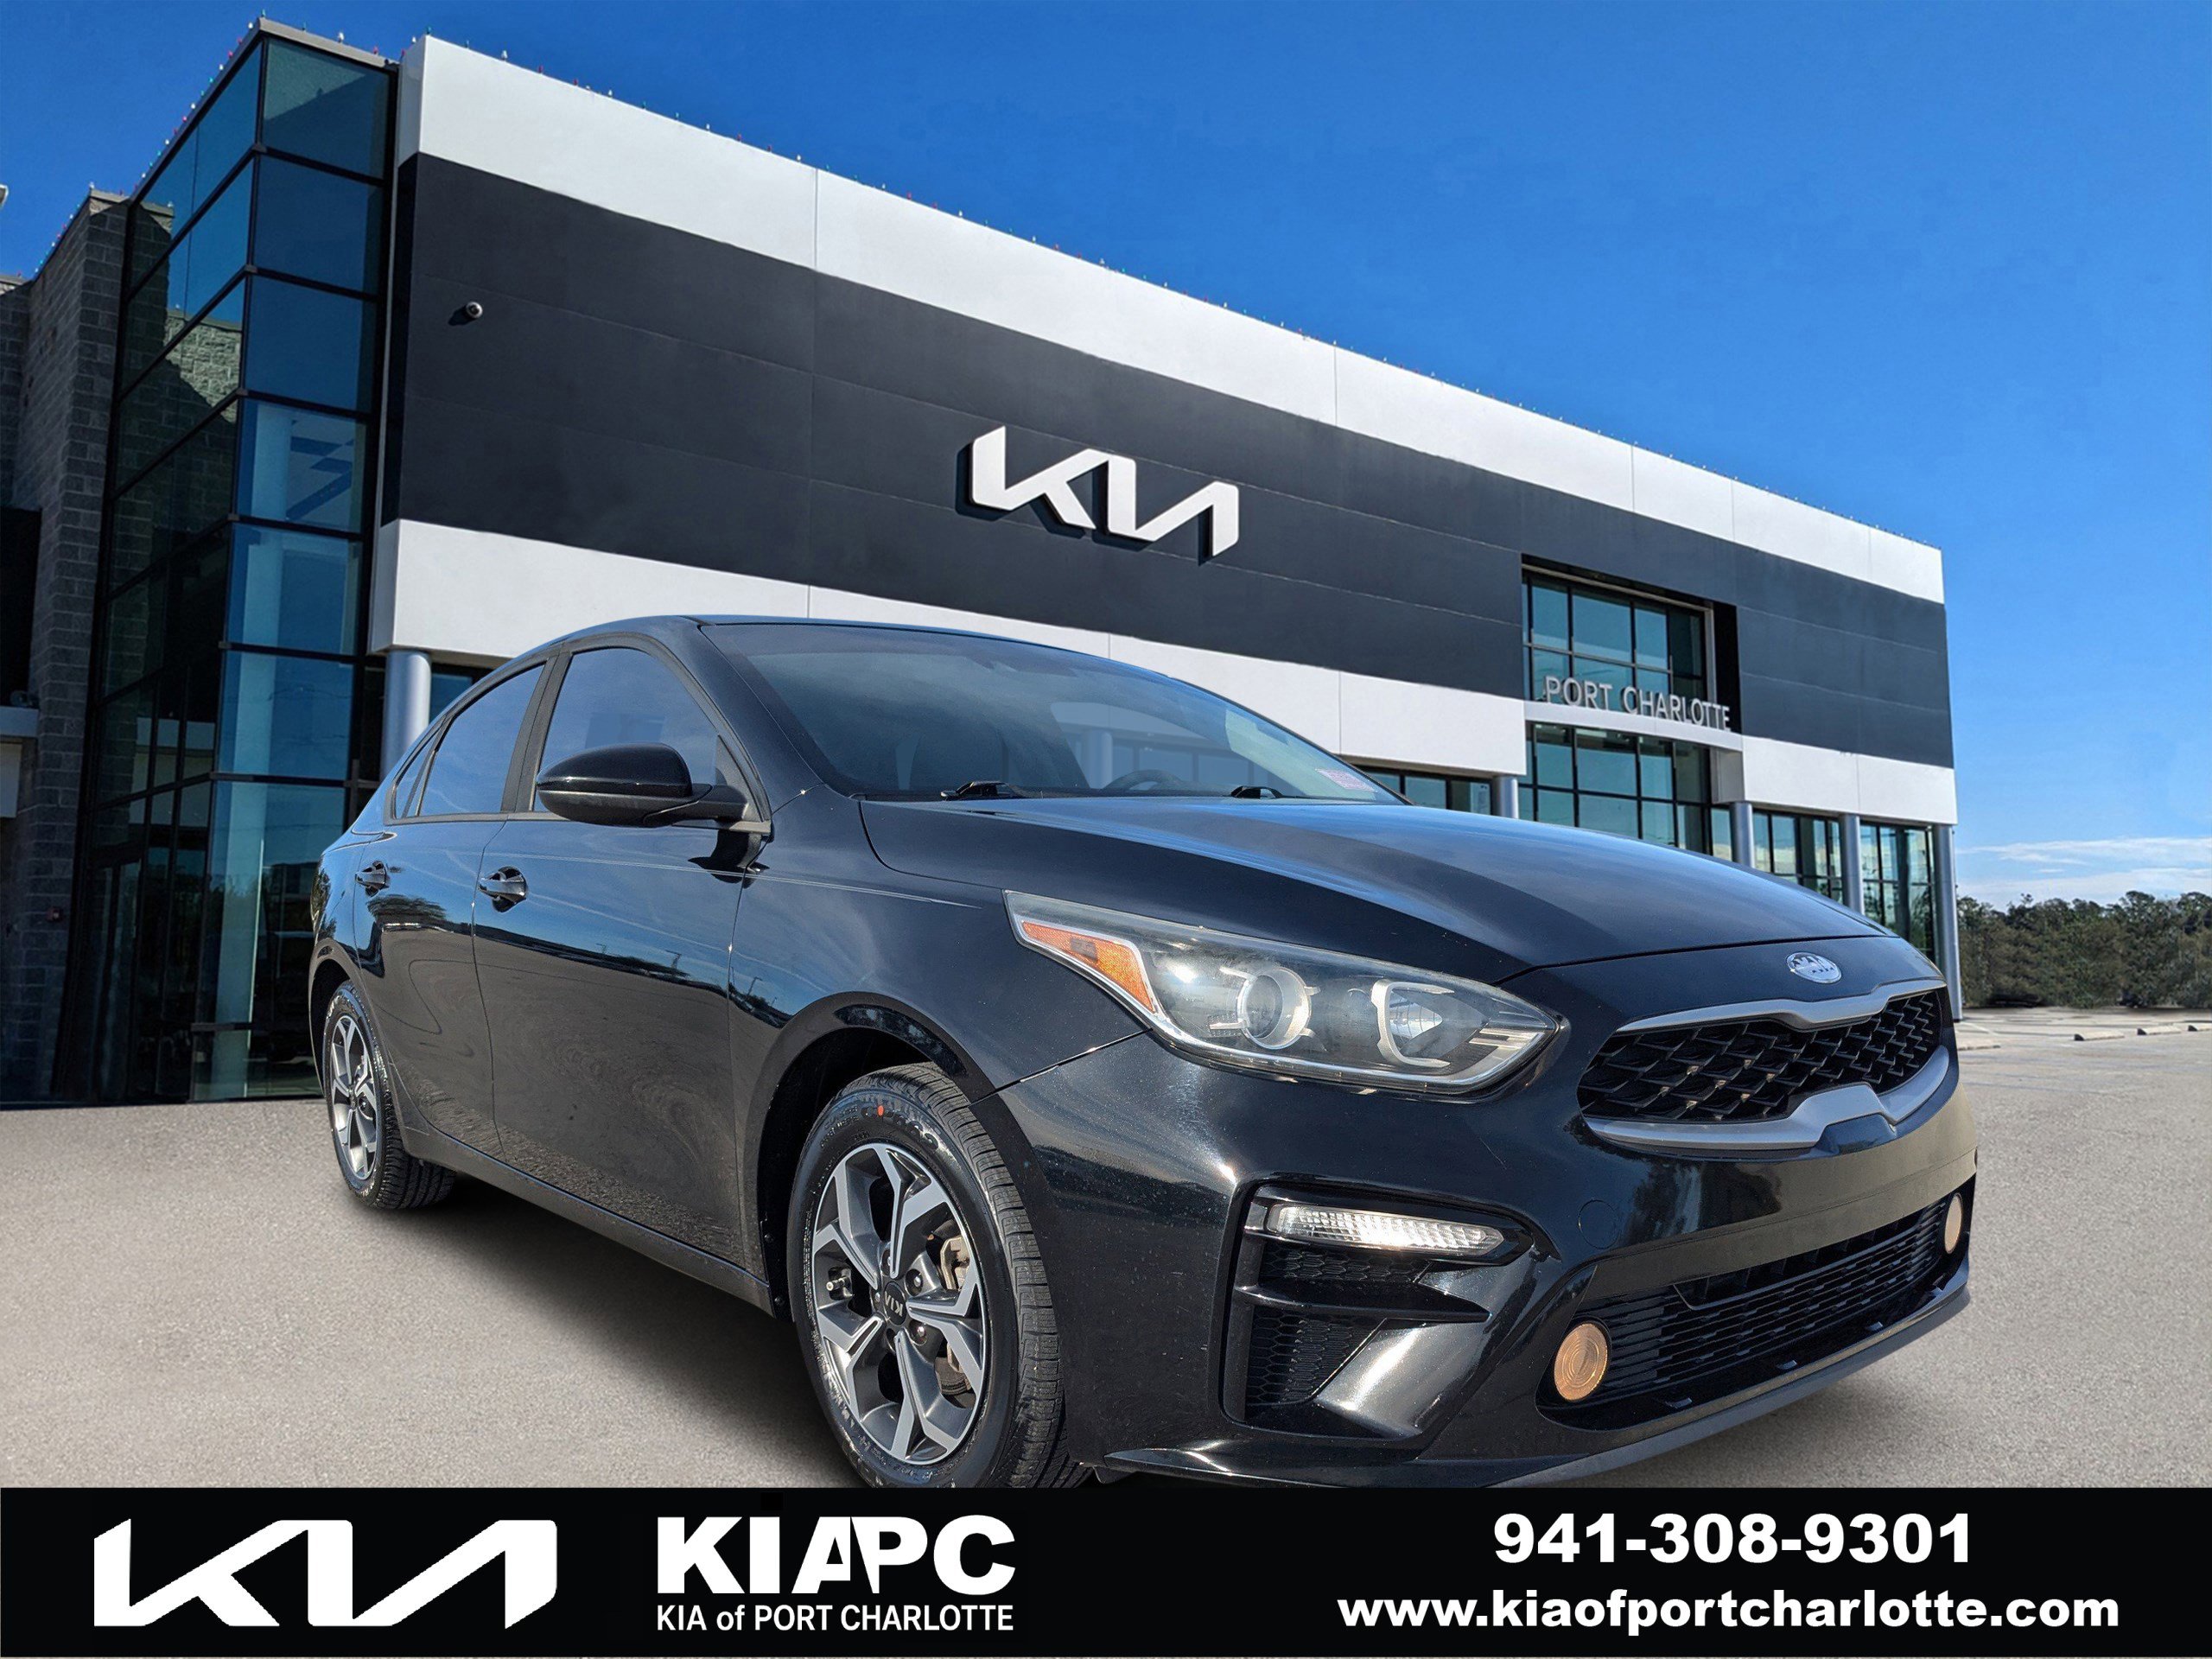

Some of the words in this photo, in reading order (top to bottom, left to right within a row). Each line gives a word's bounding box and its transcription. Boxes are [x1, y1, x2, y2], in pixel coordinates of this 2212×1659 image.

[972, 426, 1239, 557] KIA
[1544, 676, 1612, 710] PORT
[1622, 686, 1732, 732] CHARLOTTE
